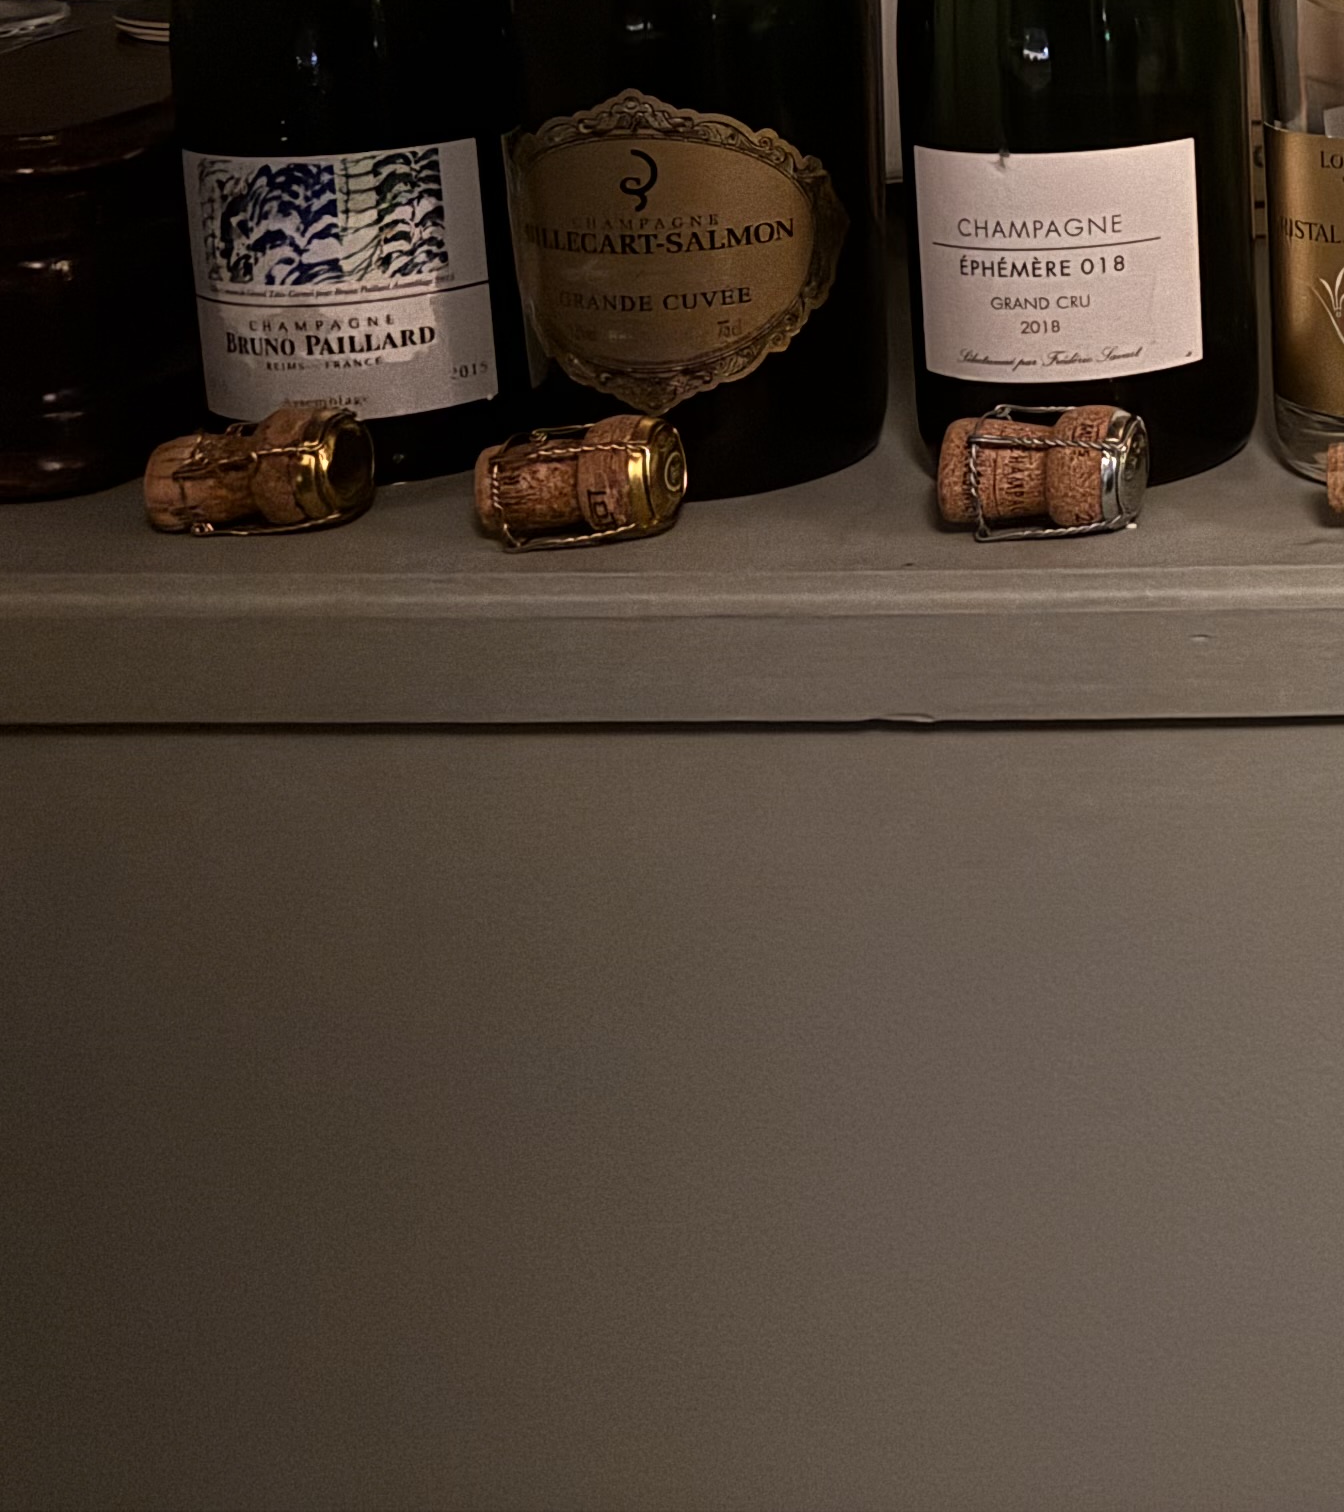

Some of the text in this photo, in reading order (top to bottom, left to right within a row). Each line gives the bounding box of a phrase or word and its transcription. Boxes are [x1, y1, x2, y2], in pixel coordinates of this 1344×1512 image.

[957, 214, 1122, 238] CHAMPAGNE
[959, 254, 1125, 278] ÉPHÉMÈRE 018
[563, 290, 653, 312] GRANDE
[990, 294, 1091, 310] GRAND CRU
[249, 314, 394, 332] CHAMPAGNE
[1020, 320, 1060, 334] 2018
[226, 326, 436, 357] BRUNO PAILLARD
[266, 356, 382, 372] REIMS FRANCE
